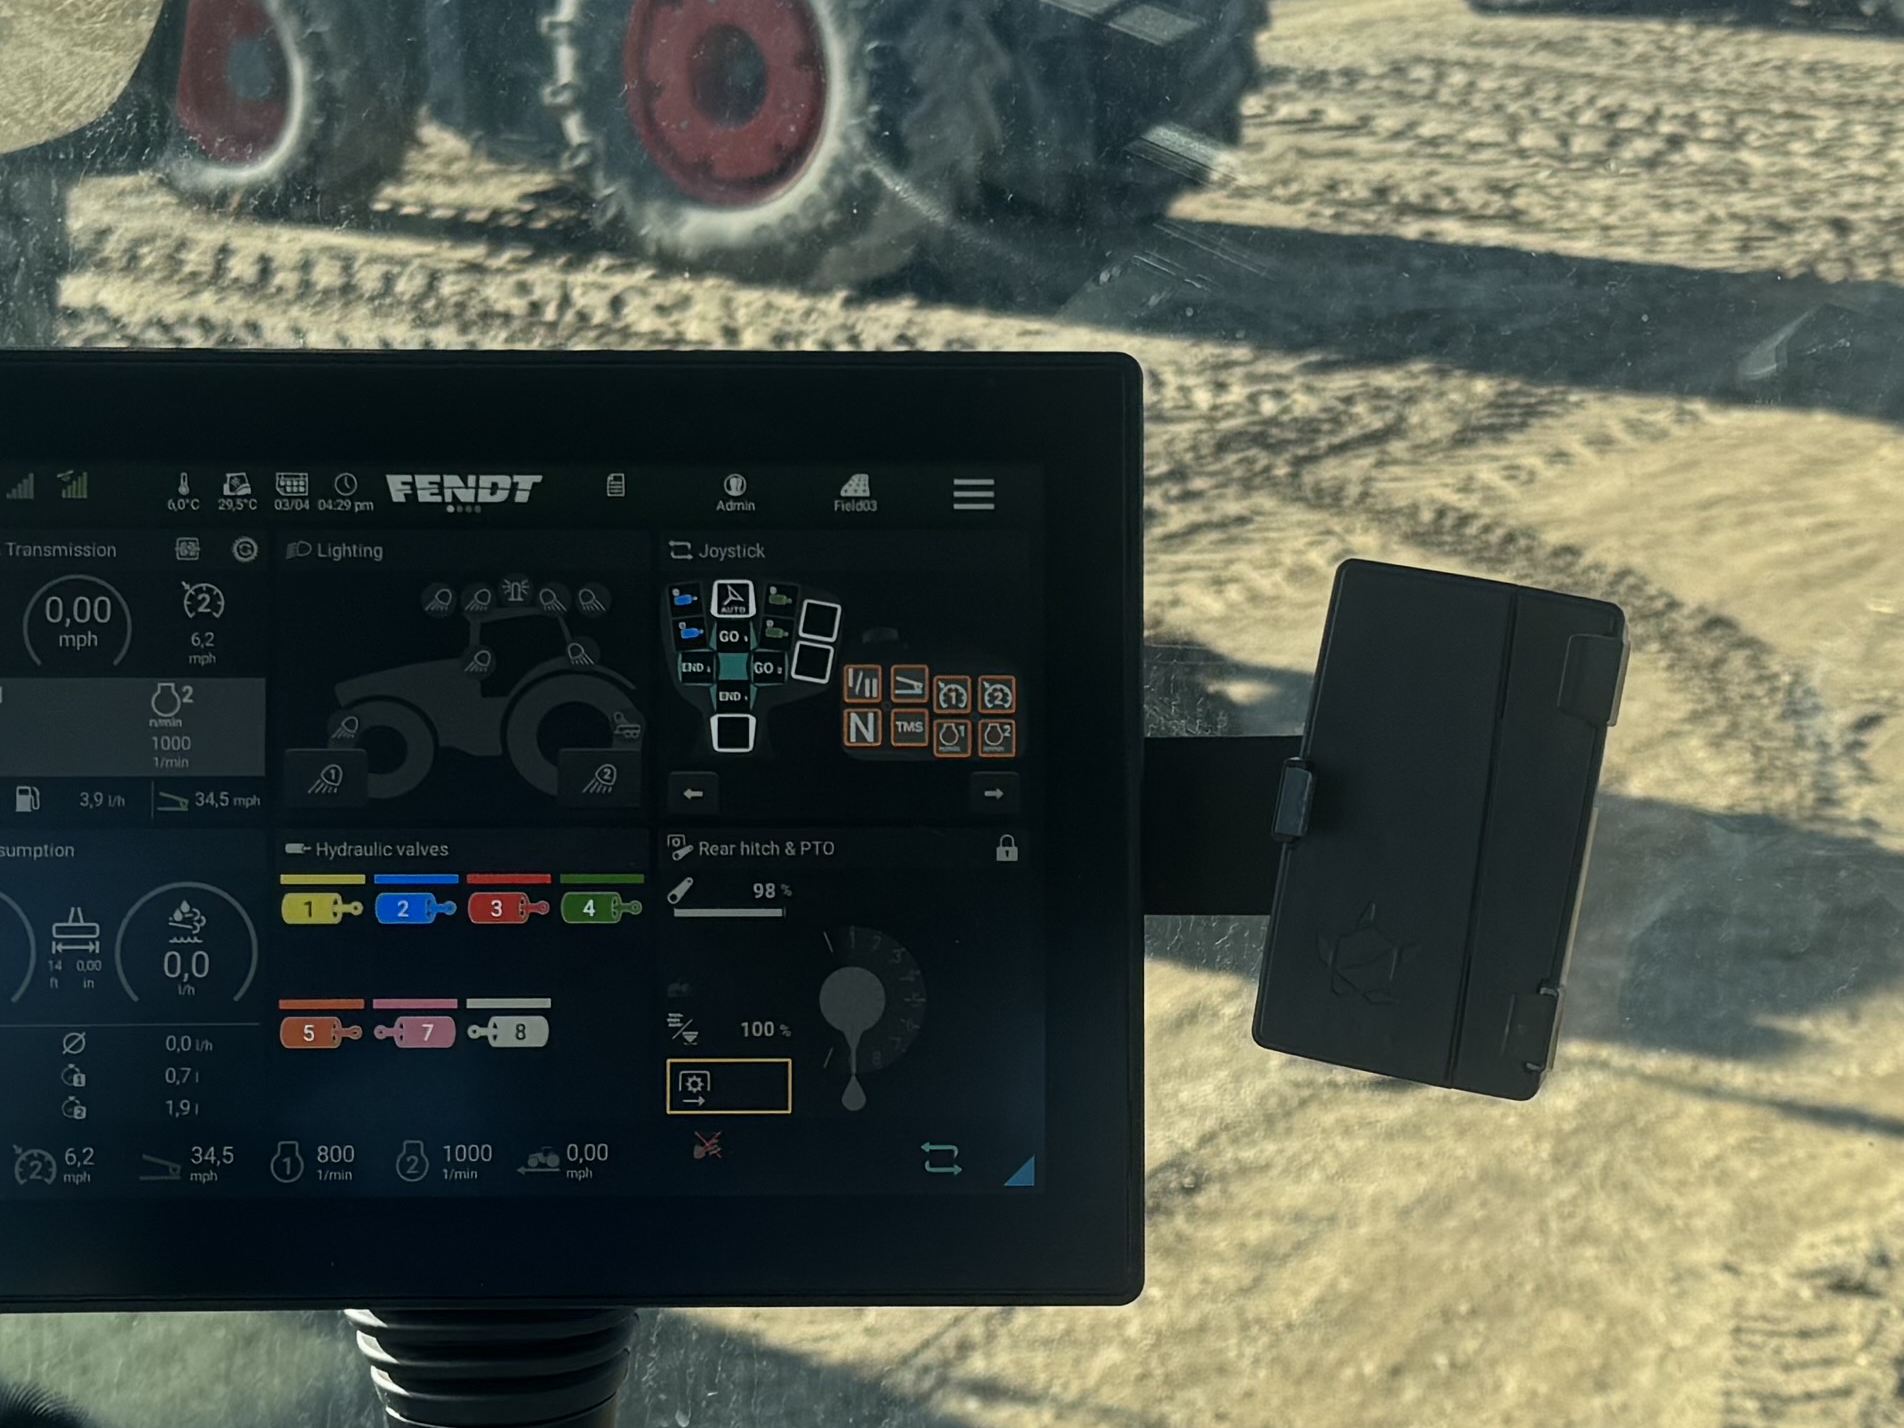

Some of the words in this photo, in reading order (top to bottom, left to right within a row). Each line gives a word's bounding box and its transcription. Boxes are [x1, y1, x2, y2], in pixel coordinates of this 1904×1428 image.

[385, 473, 544, 504] FENDT
[167, 499, 200, 512] 6,0°C
[217, 498, 258, 513] 29,5°C
[274, 498, 310, 512] 03/04
[317, 498, 352, 512] 04:29
[354, 500, 375, 513] pm
[715, 499, 756, 513] Admin
[833, 499, 878, 513] Field03
[5, 542, 117, 558] Transmission
[317, 542, 384, 562] Lighting
[698, 542, 766, 563] Joystick
[45, 595, 112, 628] 0,00
[197, 594, 212, 613] 2
[58, 632, 99, 652] mph
[190, 631, 215, 649] 6,2
[719, 631, 740, 643] GO
[188, 652, 217, 666] mph
[753, 662, 774, 674] GO
[181, 685, 195, 704] 2
[719, 691, 741, 702] END
[949, 691, 958, 705] 1
[993, 691, 1004, 705] 2
[849, 712, 875, 742] N
[895, 721, 924, 733] TMS
[1002, 724, 1012, 737] 2
[151, 735, 192, 751] 1000
[152, 756, 190, 769] 1/min
[601, 768, 613, 781] 2
[79, 792, 104, 810] 3,9
[107, 794, 126, 808] l/h
[194, 791, 230, 810] 34,5
[233, 795, 261, 810] mph
[315, 841, 393, 861] Hydraulic
[396, 841, 450, 858] valves
[698, 841, 736, 856] Rear
[739, 841, 781, 856] hitch
[784, 841, 797, 856] &
[800, 841, 835, 856] PTO
[752, 883, 777, 899] 98
[780, 884, 793, 898] %
[303, 900, 313, 918] 1
[396, 900, 410, 918] 2
[490, 899, 503, 918] 3
[582, 899, 596, 917] 4
[47, 959, 63, 972] 14
[76, 959, 103, 973] 0,00
[163, 950, 211, 982] 0,0
[49, 977, 60, 989] ft
[83, 976, 95, 989] in
[177, 983, 196, 997] l/h
[303, 1024, 316, 1043] 5
[421, 1023, 435, 1042] 7
[514, 1023, 527, 1041] 8
[741, 1021, 776, 1038] 100
[779, 1024, 793, 1037] %
[165, 1035, 192, 1055] 0,0
[195, 1038, 214, 1053] l/h
[164, 1068, 192, 1086] 0,7
[164, 1100, 192, 1118] 1,9
[64, 1147, 95, 1168] 6,2
[190, 1145, 235, 1167] 34,5
[316, 1145, 356, 1163] 800
[442, 1144, 493, 1162] 1000
[566, 1142, 610, 1165] 0,00
[29, 1161, 43, 1180] 2
[281, 1156, 292, 1174] 1
[406, 1155, 419, 1173] 2
[63, 1171, 91, 1185] mph
[189, 1170, 219, 1185] mph
[316, 1168, 353, 1182] 1/min
[442, 1167, 479, 1181] 1/min
[565, 1167, 594, 1181] mph
